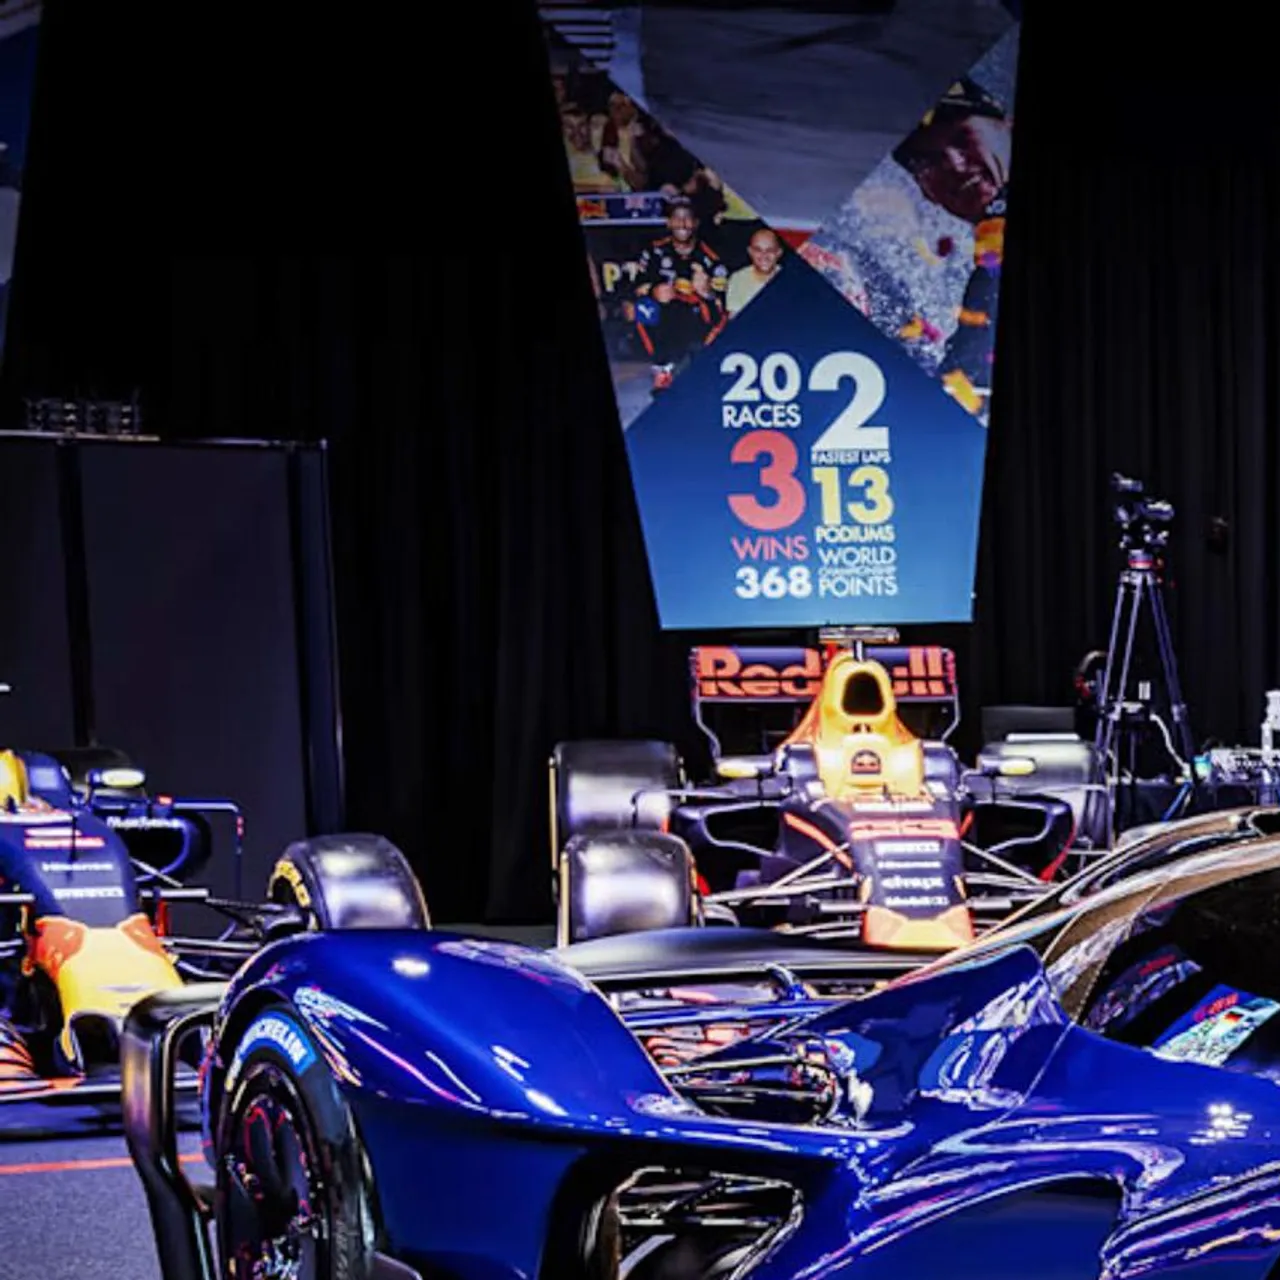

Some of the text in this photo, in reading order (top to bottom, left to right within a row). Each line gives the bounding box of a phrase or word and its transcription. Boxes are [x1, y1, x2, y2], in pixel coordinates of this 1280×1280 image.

[720, 353, 801, 402] 20
[722, 404, 801, 428] RACES
[808, 351, 889, 450] 2
[727, 430, 806, 531] 3
[812, 465, 894, 526] 13
[731, 537, 809, 560] WINS
[815, 525, 895, 543] PODIUMS
[817, 546, 896, 565] WORLD
[735, 566, 813, 600] 368
[818, 576, 898, 598] POINTS
[697, 647, 822, 696] Red
